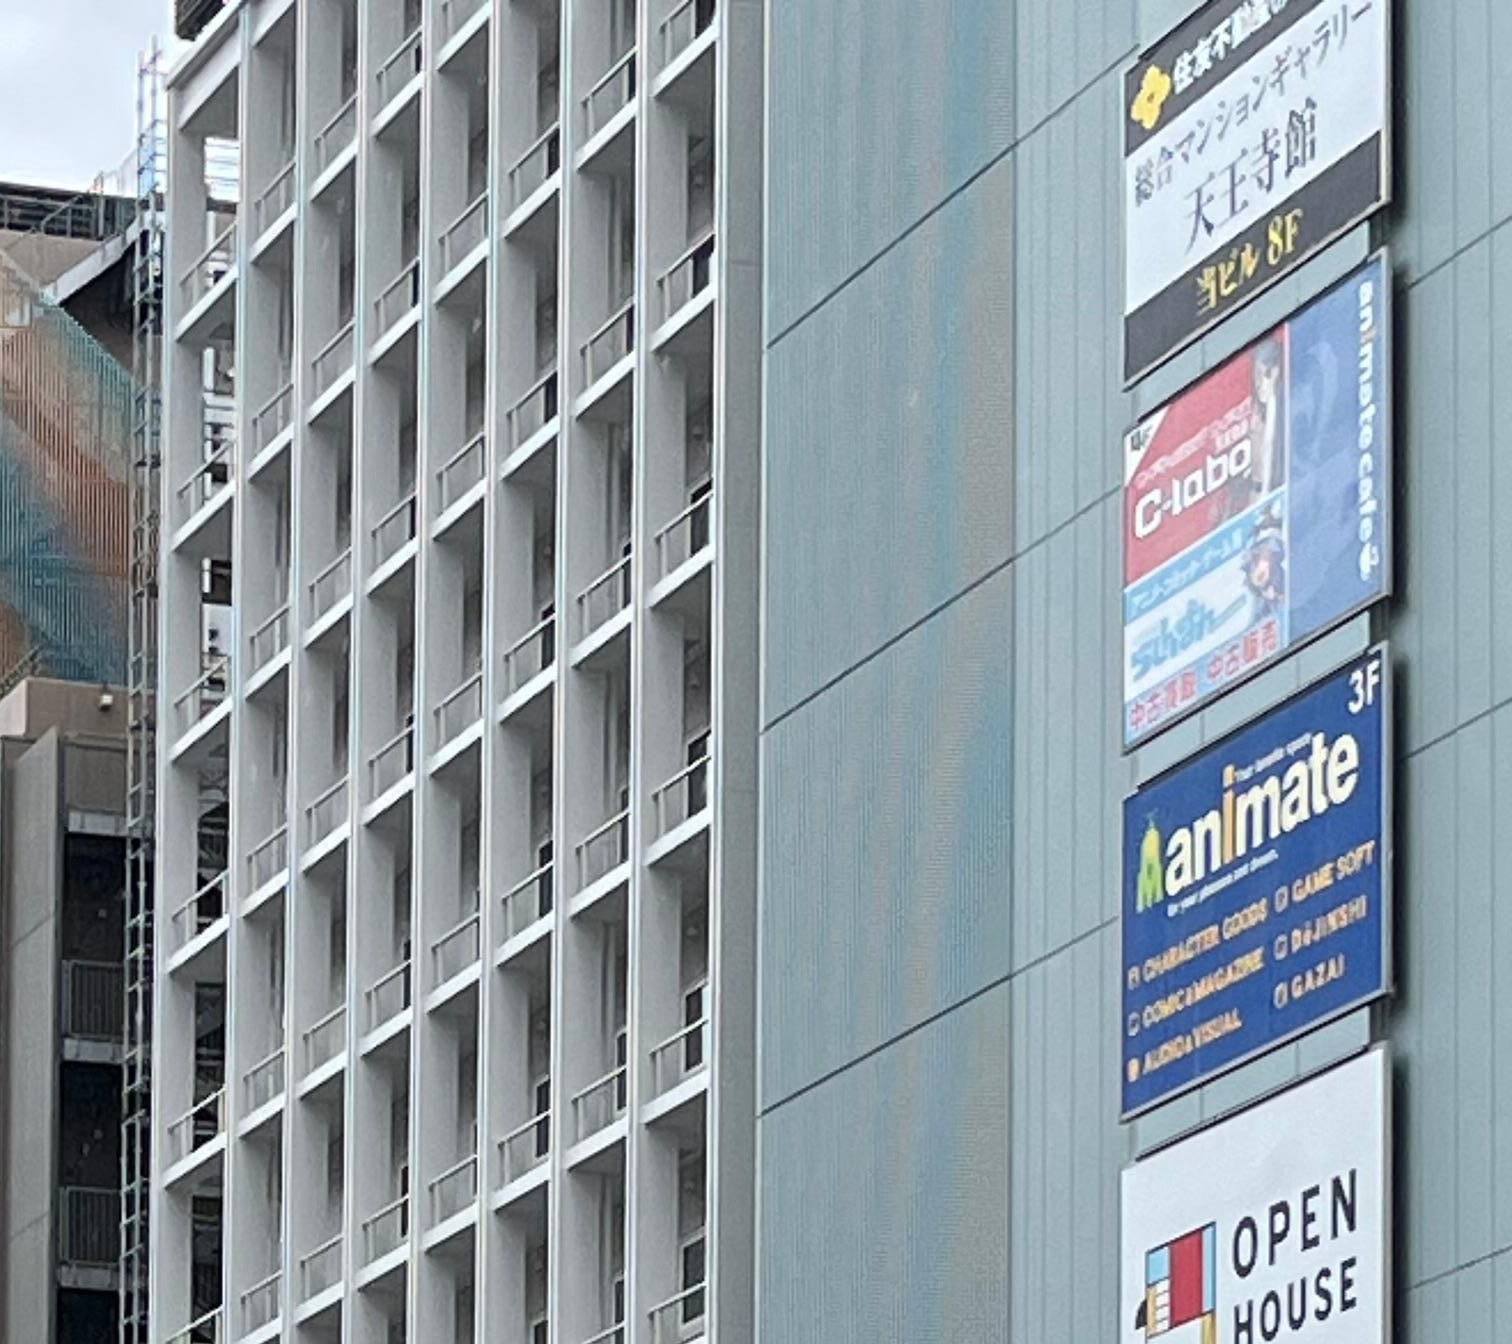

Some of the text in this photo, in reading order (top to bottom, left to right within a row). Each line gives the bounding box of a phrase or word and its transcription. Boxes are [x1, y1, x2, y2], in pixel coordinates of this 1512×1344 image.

[1136, 3, 1372, 200] 総合マンションギャラリー
[1185, 97, 1318, 256] 天王寺館
[1267, 208, 1304, 266] 8F
[1348, 659, 1380, 714] 3F
[1165, 731, 1360, 897] animate
[1291, 861, 1335, 903] GAME
[1336, 839, 1376, 881] SOFT
[1232, 1167, 1357, 1279] OPEN
